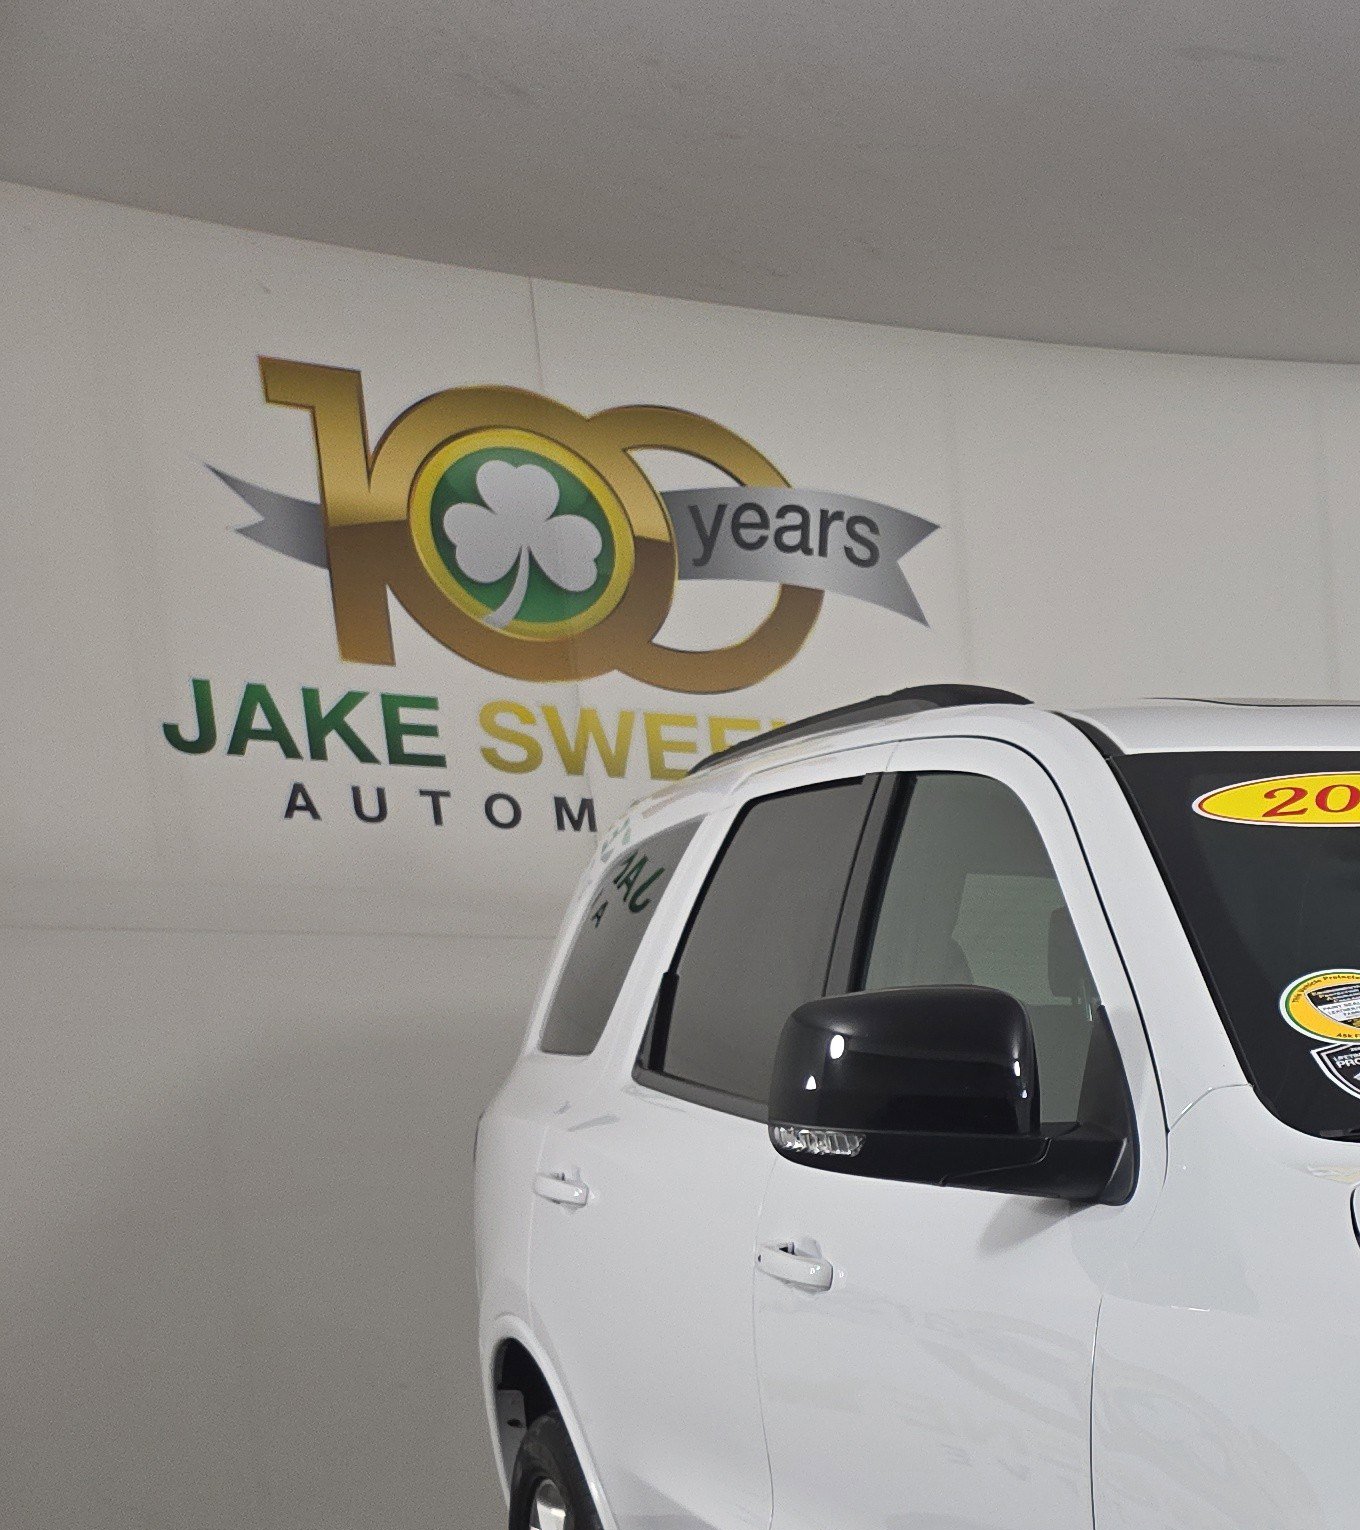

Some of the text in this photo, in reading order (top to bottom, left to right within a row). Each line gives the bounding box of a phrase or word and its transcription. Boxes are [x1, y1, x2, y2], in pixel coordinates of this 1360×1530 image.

[687, 493, 882, 569] years
[162, 677, 786, 782] JAKE SWEE
[283, 782, 598, 832] AUTOM
